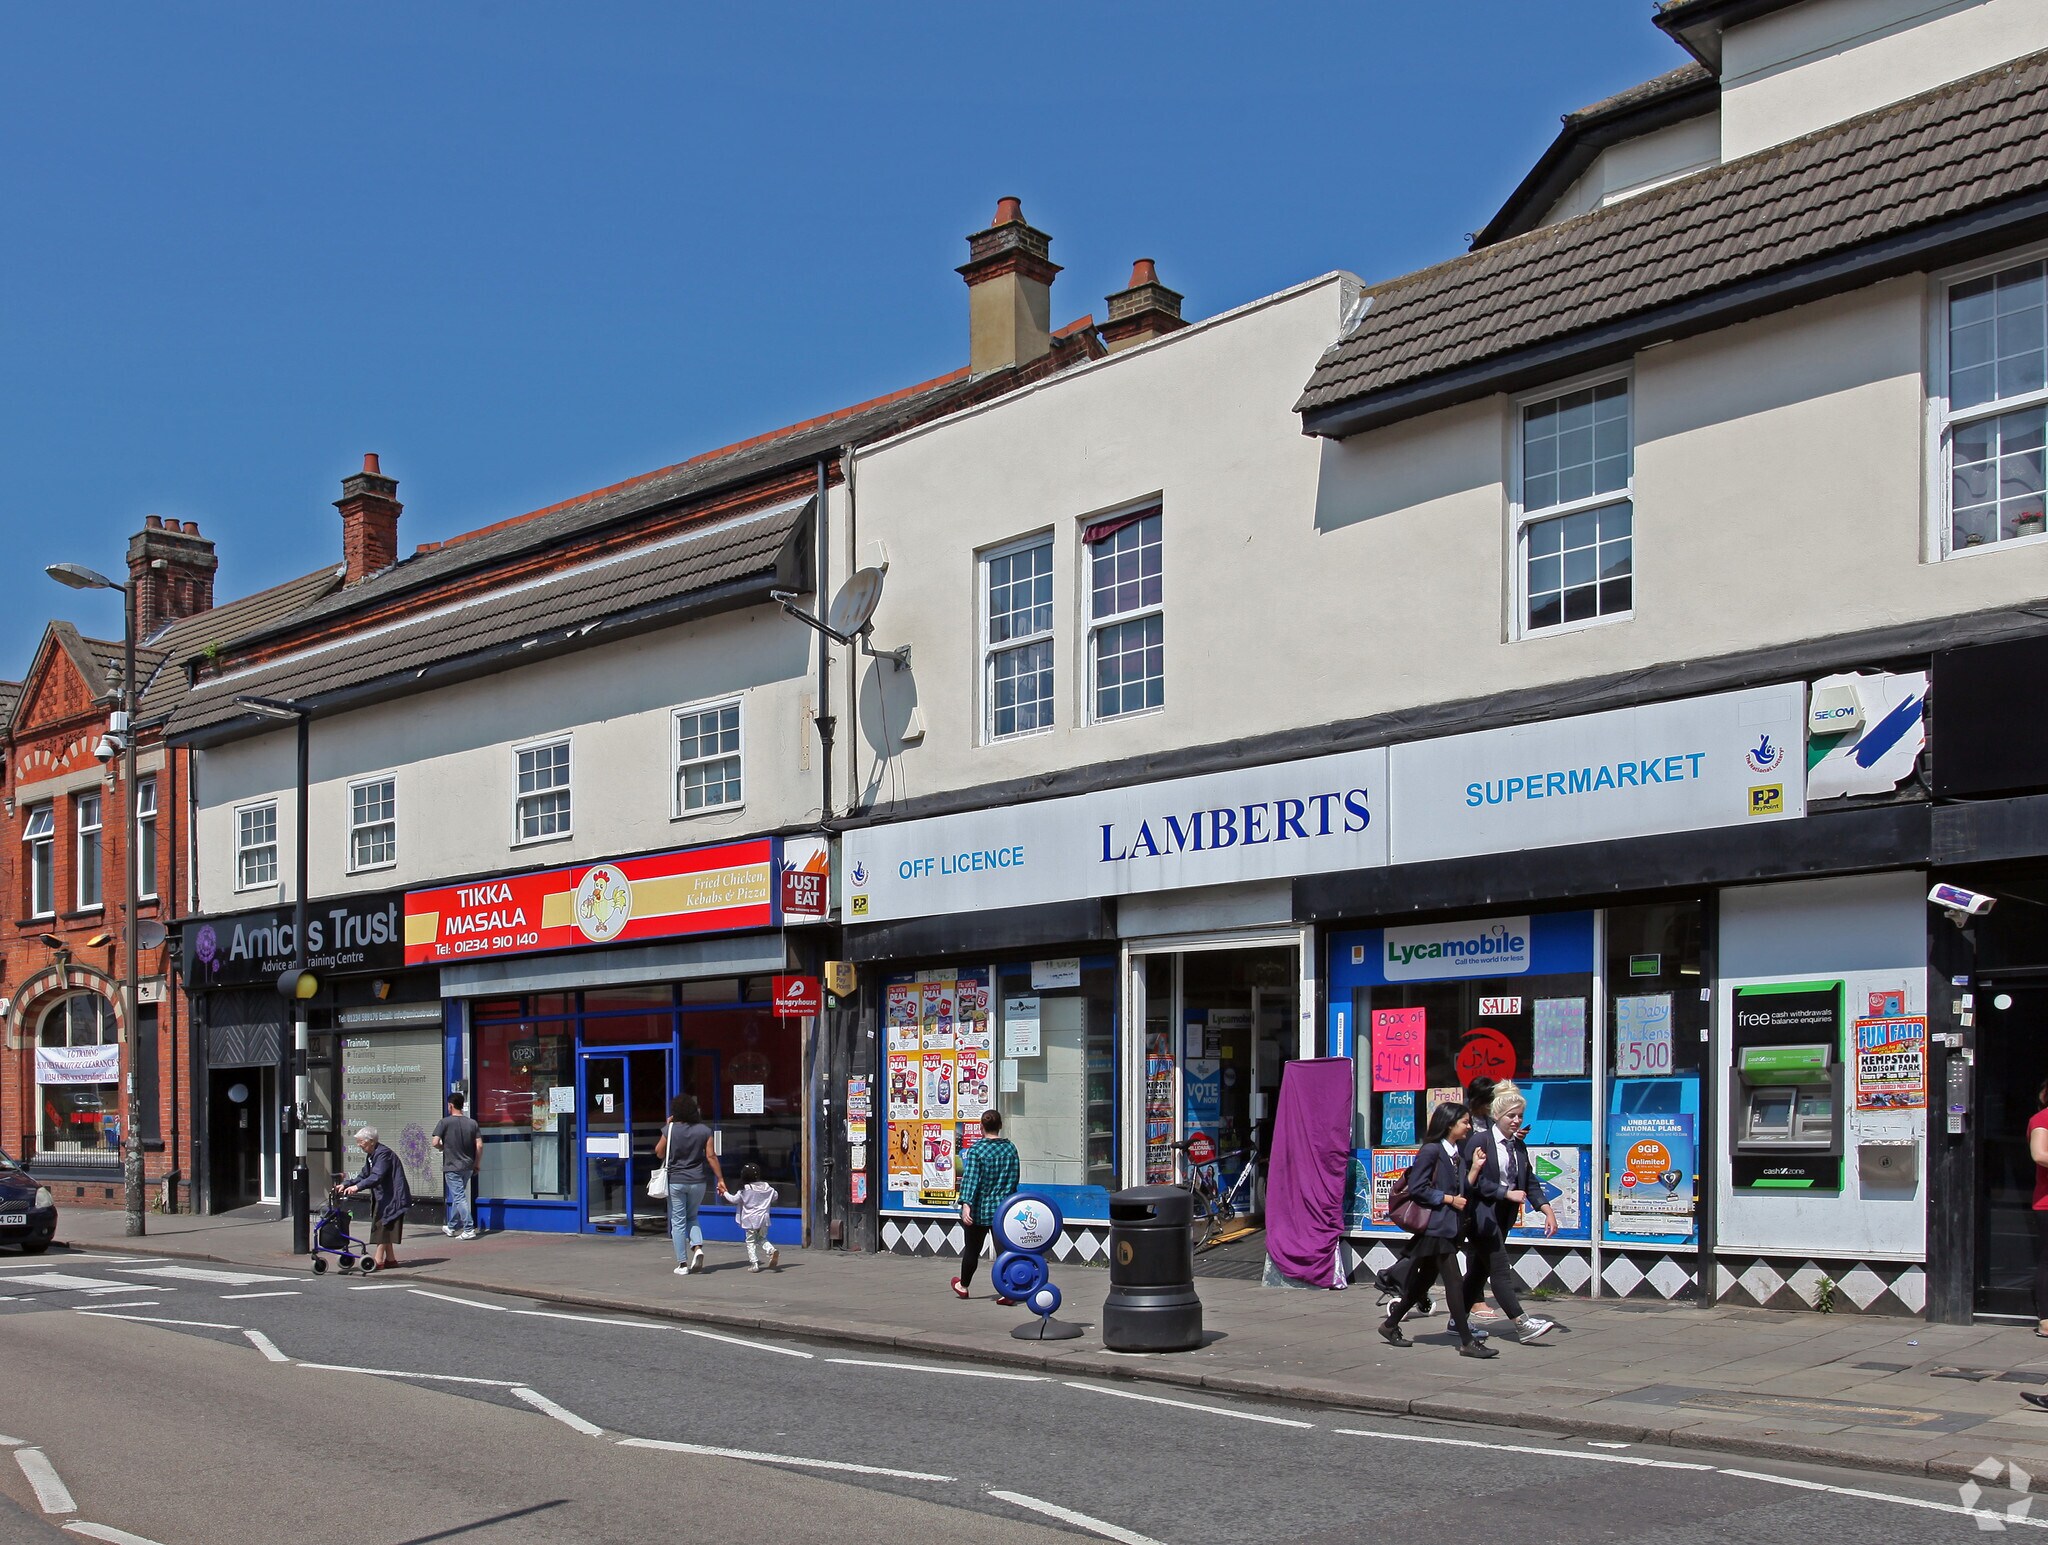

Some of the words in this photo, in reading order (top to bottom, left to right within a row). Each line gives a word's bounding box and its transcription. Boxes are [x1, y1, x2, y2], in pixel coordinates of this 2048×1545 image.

[1814, 707, 1854, 720] SECOM
[1465, 752, 1706, 808] SUPERMARKET
[1099, 788, 1371, 863] LAMBERTS
[899, 857, 935, 880] OFF
[941, 845, 1025, 875] LICENCE
[694, 876, 720, 891] Fried
[722, 872, 766, 886] Chicken,
[787, 875, 820, 891] JUST
[456, 883, 513, 908] TIKKA
[686, 891, 722, 907] Kebabs
[725, 891, 734, 902] &
[737, 887, 766, 900] Pizza
[795, 891, 819, 906] EAT
[329, 902, 398, 949] Trust
[445, 907, 527, 936] MASALA
[435, 943, 451, 955] Tel:
[454, 938, 488, 952] 01234
[492, 935, 512, 949] 910
[517, 932, 538, 946] 140
[1389, 930, 1525, 965] Lycamobile
[262, 959, 286, 972] Advice
[288, 961, 297, 970] an
[307, 954, 335, 968] raining
[336, 952, 364, 964] Centre
[1455, 957, 1468, 966] Call
[1468, 957, 1480, 965] the
[1480, 956, 1500, 964] world
[889, 993, 907, 1001] DEAL
[923, 990, 940, 998] DEAL
[958, 987, 976, 996] DEAL
[1482, 998, 1519, 1014] SALE
[1618, 998, 1631, 1020] 3
[1635, 995, 1669, 1021] Baby
[1738, 1010, 1770, 1026] free
[1789, 1009, 1832, 1017] withdrawals
[1771, 1017, 1799, 1025] balance
[1800, 1016, 1832, 1024] enquiries
[1858, 1025, 1886, 1048] FUN
[1890, 1023, 1923, 1041] FAIR
[347, 1038, 370, 1049] Training
[512, 1047, 535, 1061] OPEN
[1462, 1045, 1505, 1069] حلال
[1861, 1054, 1919, 1065] KEMPSTON
[347, 1065, 376, 1074] Education
[377, 1065, 381, 1073] &
[383, 1064, 421, 1074] Employment
[890, 1062, 907, 1070] DEAL
[923, 1060, 940, 1068] DEAL
[958, 1059, 975, 1067] DEAL
[1861, 1065, 1895, 1073] ADDISON
[941, 1065, 951, 1077] £2
[977, 1066, 987, 1076] £5
[347, 1092, 358, 1100] Life
[359, 1091, 371, 1100] Skill
[372, 1091, 396, 1103] Support
[1187, 1083, 1218, 1102] VOTE
[1389, 1091, 1412, 1105] Fresh
[1434, 1089, 1461, 1101] Fresh
[348, 1119, 367, 1127] Advice
[923, 1130, 941, 1138] DEAL
[348, 1145, 360, 1153] Hire
[941, 1144, 949, 1152] £7
[1637, 1145, 1659, 1153] 9GB
[1376, 1155, 1394, 1173] FUN
[6, 1215, 23, 1223] GZD
